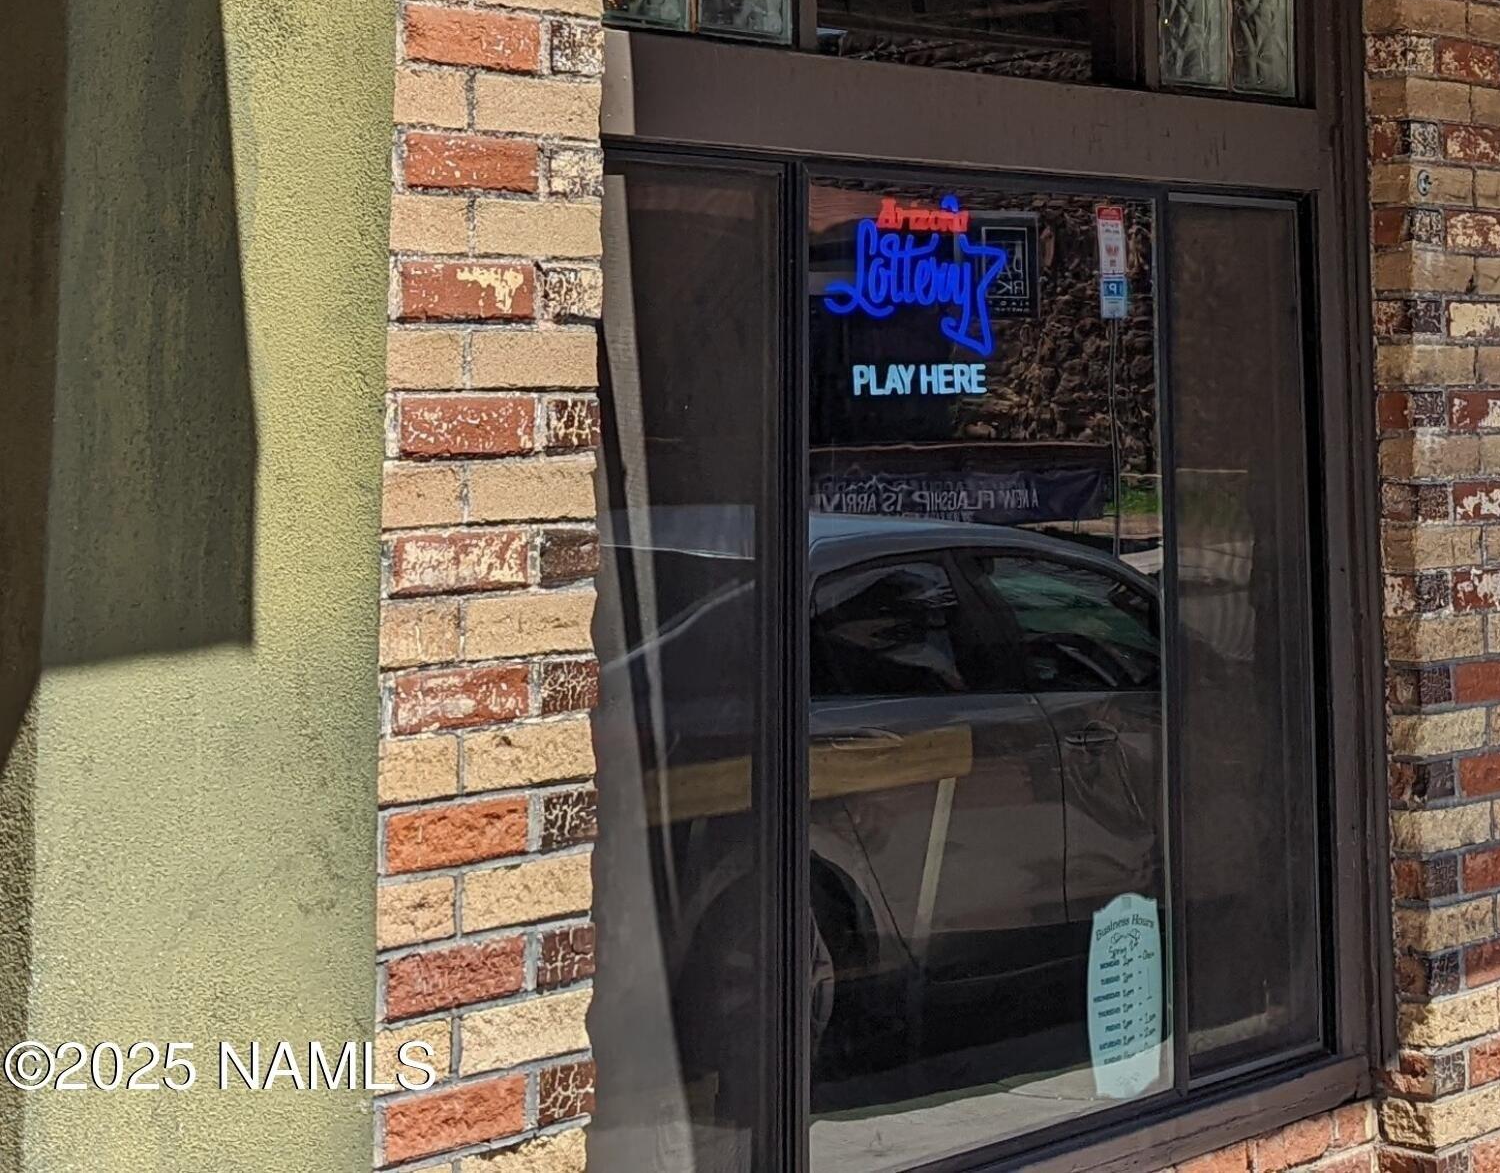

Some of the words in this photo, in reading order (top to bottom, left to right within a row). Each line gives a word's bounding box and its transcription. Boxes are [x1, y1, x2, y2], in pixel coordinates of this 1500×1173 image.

[824, 218, 977, 338] Lottery
[853, 364, 915, 396] PLAY
[919, 363, 988, 394] HERE
